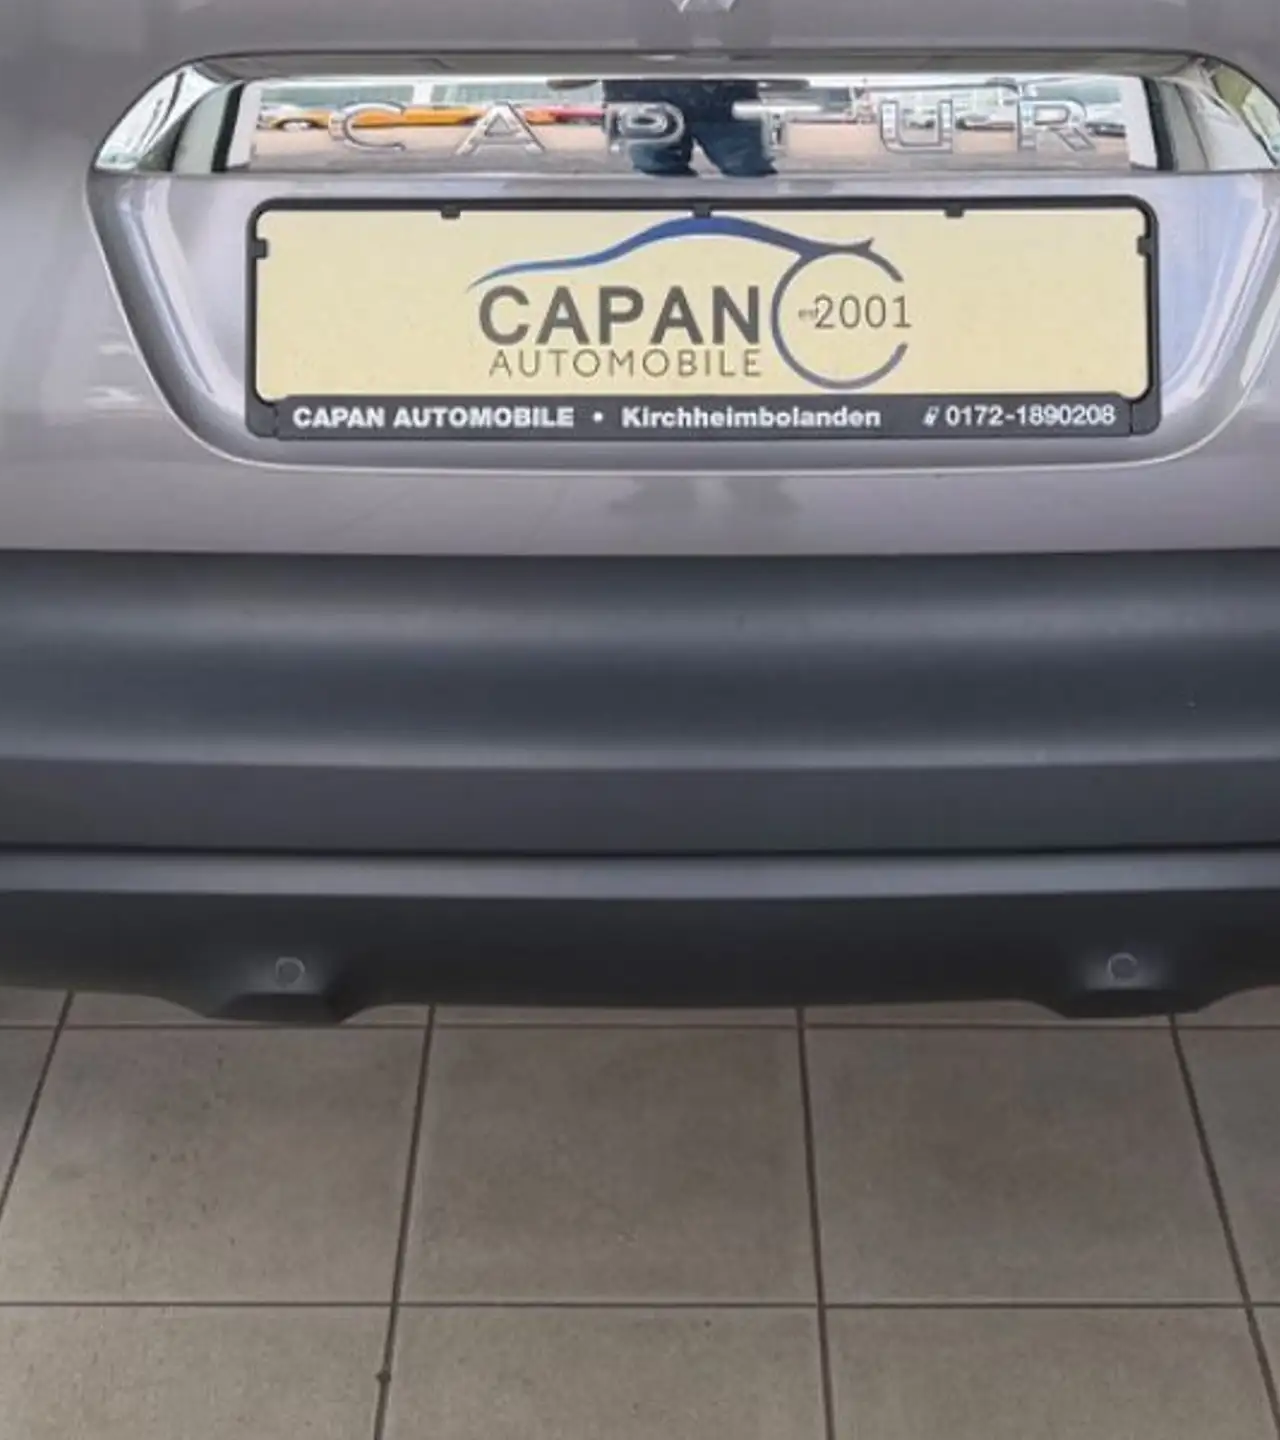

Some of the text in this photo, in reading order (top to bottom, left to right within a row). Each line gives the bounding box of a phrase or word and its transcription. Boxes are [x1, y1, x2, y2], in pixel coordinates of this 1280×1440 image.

[328, 99, 1099, 156] CAPTUR
[478, 284, 760, 346] CAPAN
[814, 293, 912, 329] 2001
[488, 348, 762, 378] AUTOMOBILE
[292, 404, 1117, 429] CAPAN AUTOMOBILE Kirchheimbolanden 0172-1890208
